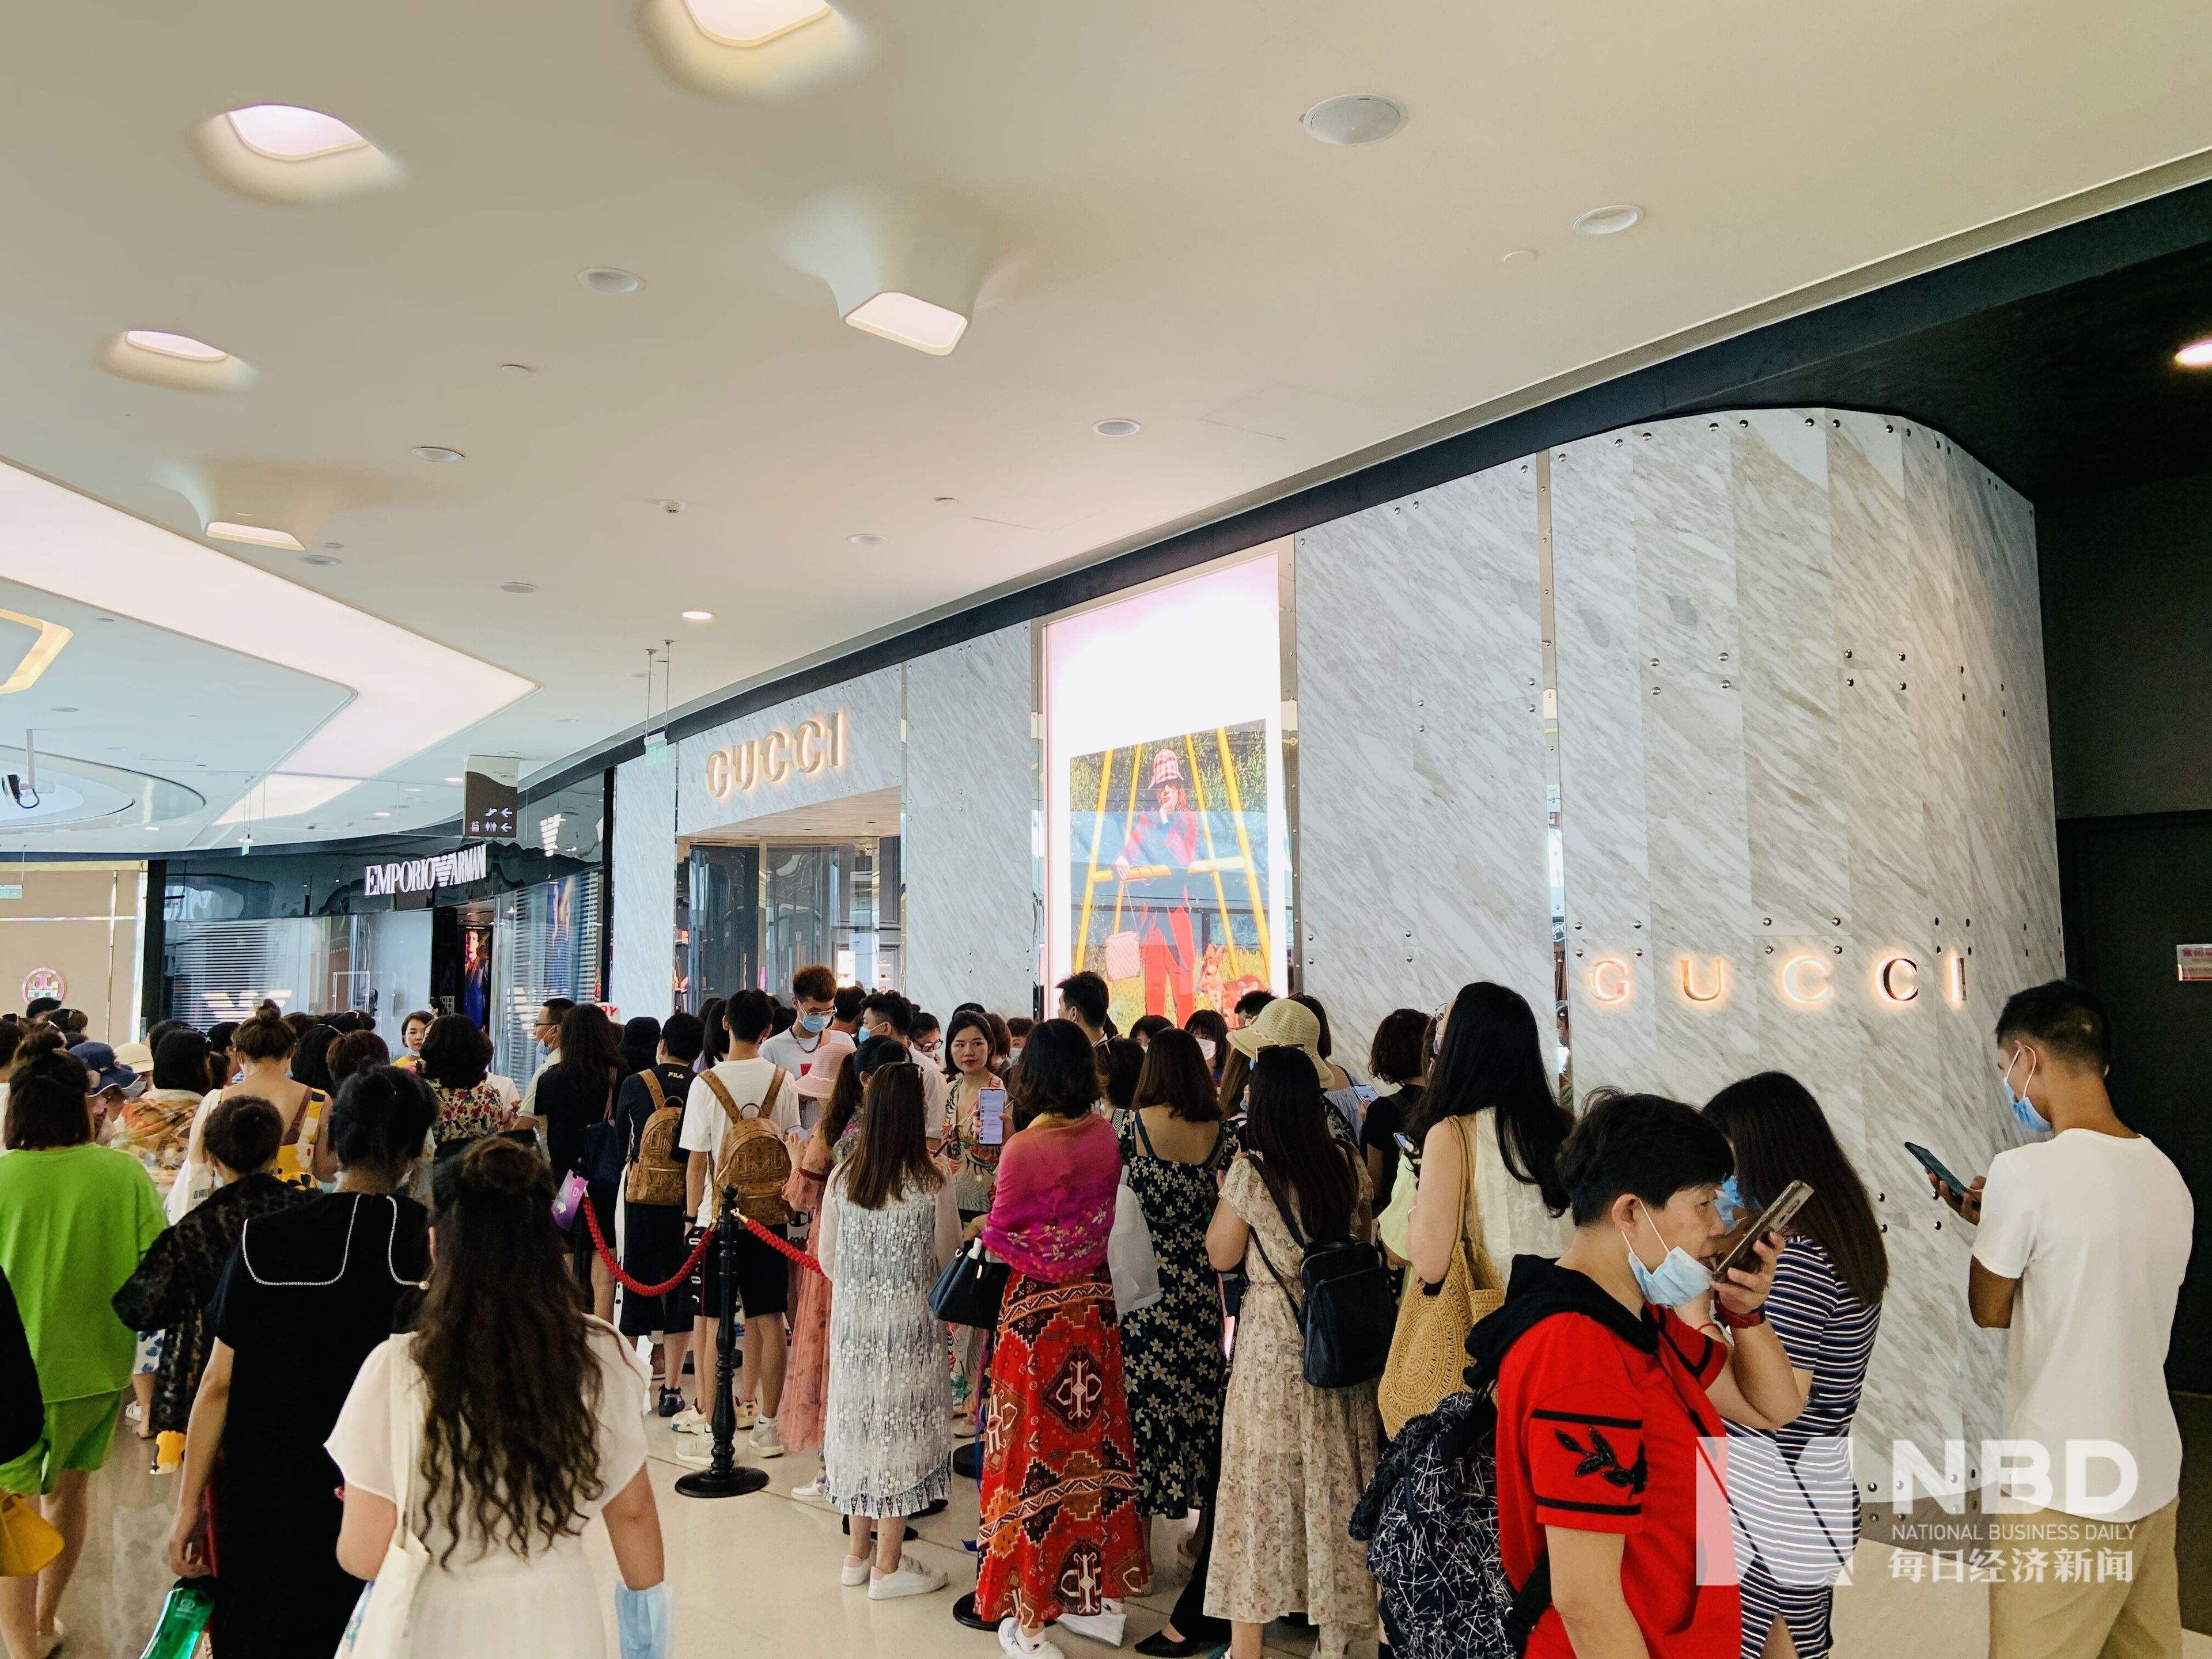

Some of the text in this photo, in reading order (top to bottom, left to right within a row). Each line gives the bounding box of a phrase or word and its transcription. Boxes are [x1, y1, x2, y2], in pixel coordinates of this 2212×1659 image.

[705, 713, 843, 798] GUCCI
[364, 843, 487, 896] EMPORIO ARMANI
[1588, 956, 1967, 1004] GUCCI
